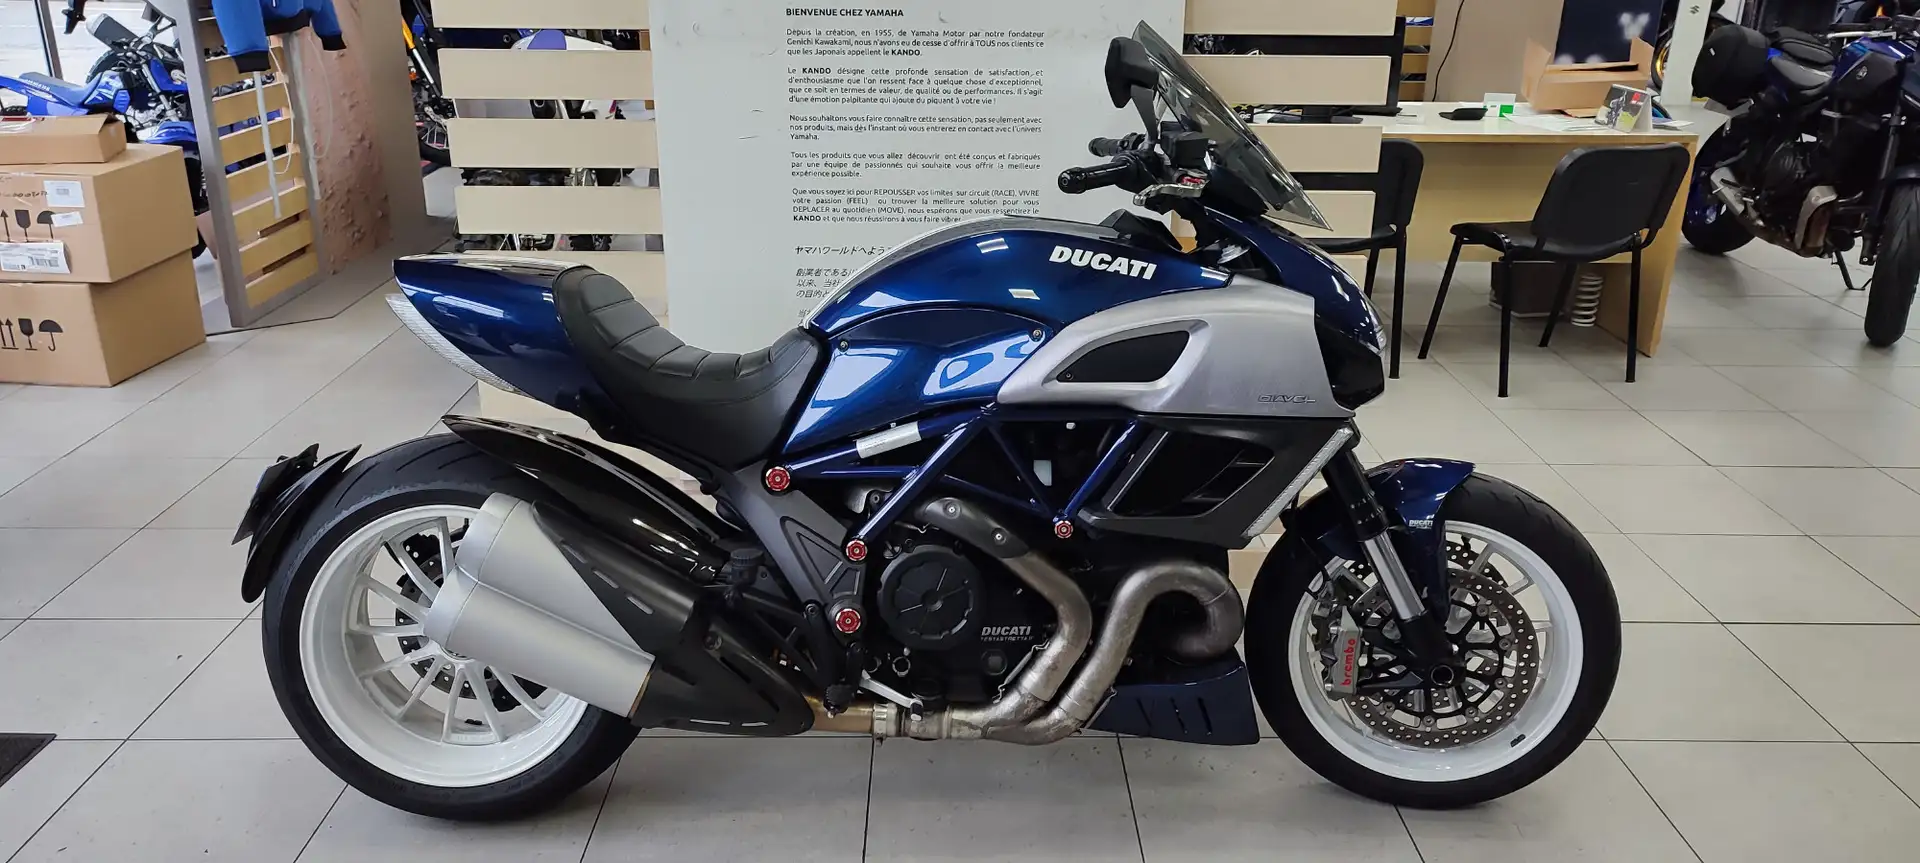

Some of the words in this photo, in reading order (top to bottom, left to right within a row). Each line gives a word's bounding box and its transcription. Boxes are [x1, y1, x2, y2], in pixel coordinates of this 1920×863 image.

[826, 29, 857, 37] création,
[875, 29, 894, 38] 1955,
[815, 38, 853, 47] Kawakami,
[815, 48, 845, 56] Japonais
[837, 67, 865, 76] désigne
[896, 68, 928, 76] profonde
[934, 77, 962, 86] quelque
[916, 87, 940, 95] qualité
[842, 96, 878, 104] palpitante
[927, 96, 953, 105] piquant
[822, 152, 851, 160] produits
[824, 161, 847, 169] équipe
[865, 161, 902, 170] passionnés
[792, 169, 829, 178] expérience
[832, 170, 861, 178] possible.
[792, 187, 806, 196] Que
[816, 197, 841, 205] passion
[843, 206, 875, 214] quotidien
[1049, 245, 1157, 280] DUCATI
[981, 626, 1032, 636] DUCATI
[1341, 639, 1356, 686] brembo
